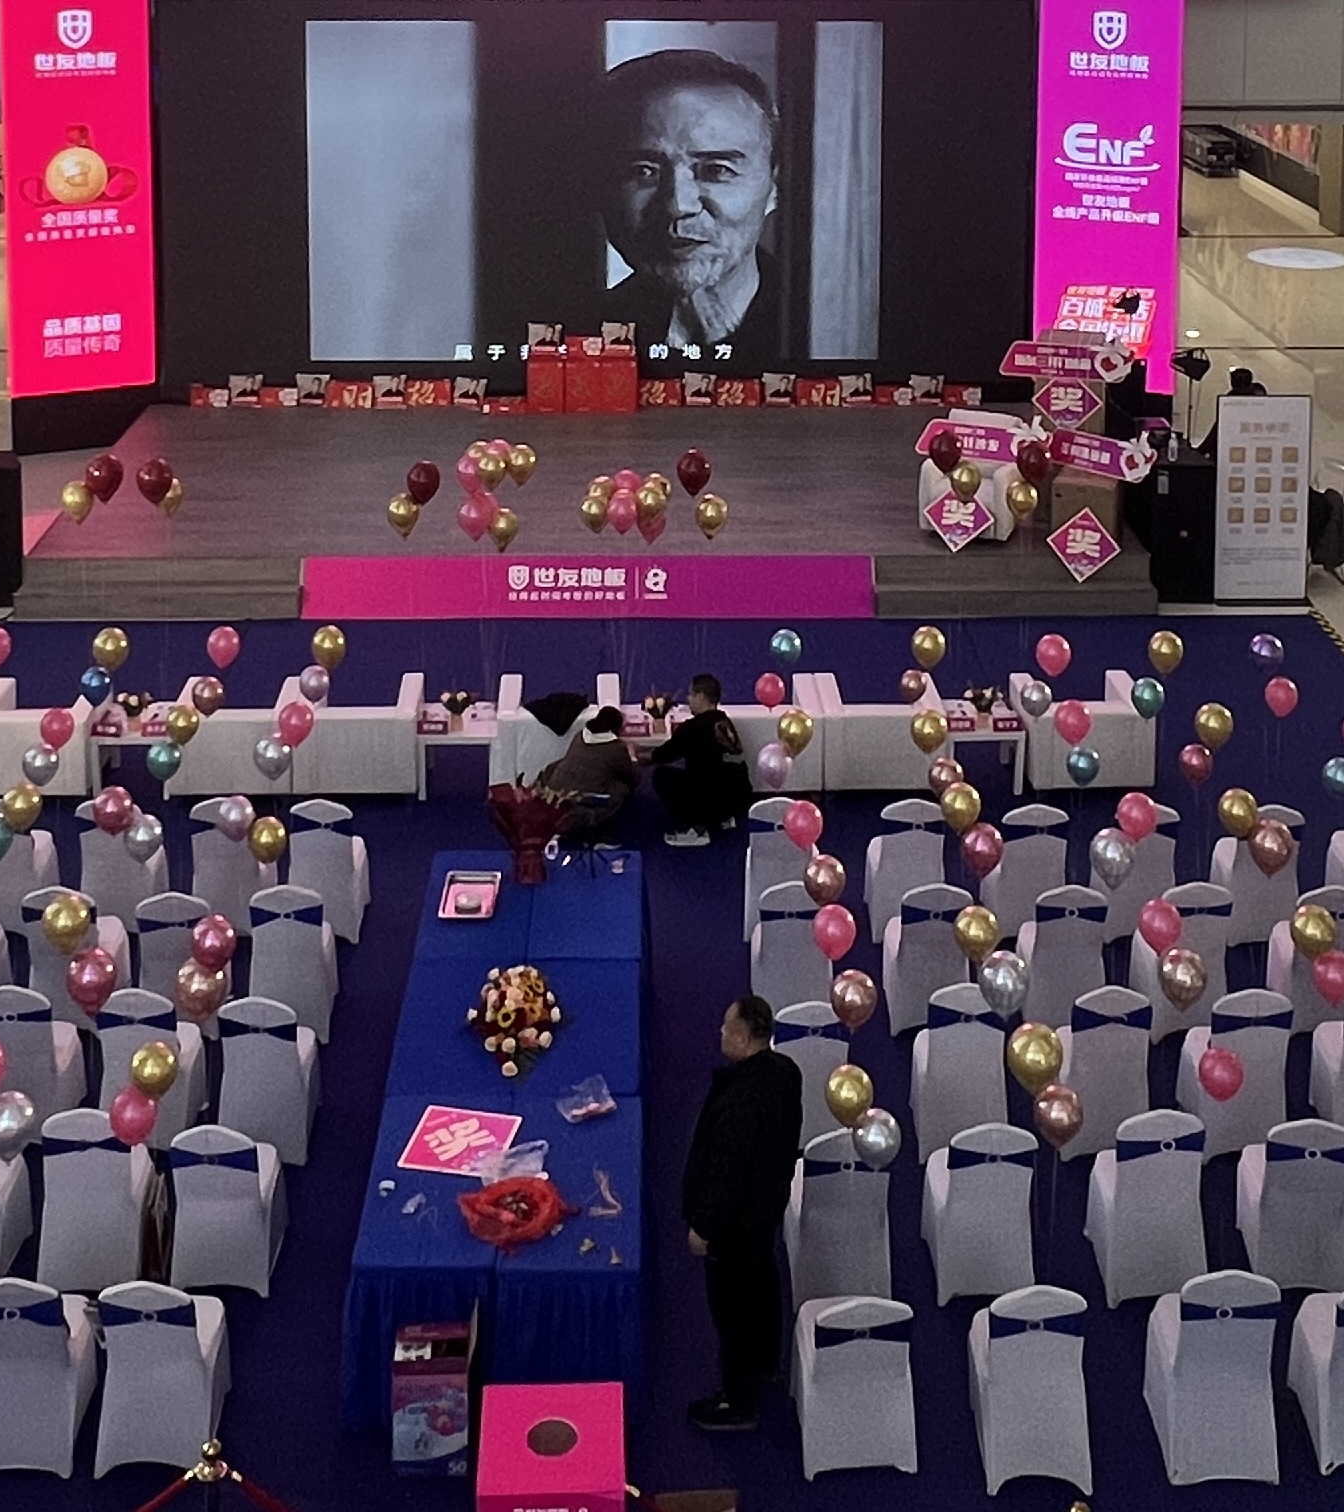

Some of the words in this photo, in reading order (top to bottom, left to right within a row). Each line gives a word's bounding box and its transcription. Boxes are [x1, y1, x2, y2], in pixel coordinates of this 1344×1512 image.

[34, 52, 117, 71] 世友地板
[1069, 51, 1150, 73] 世友地板
[1063, 122, 1147, 166] ENF
[1061, 297, 1151, 320] 百城店
[1050, 386, 1084, 413] 奖
[1065, 528, 1102, 558] 奖
[533, 566, 626, 588] 世友地板
